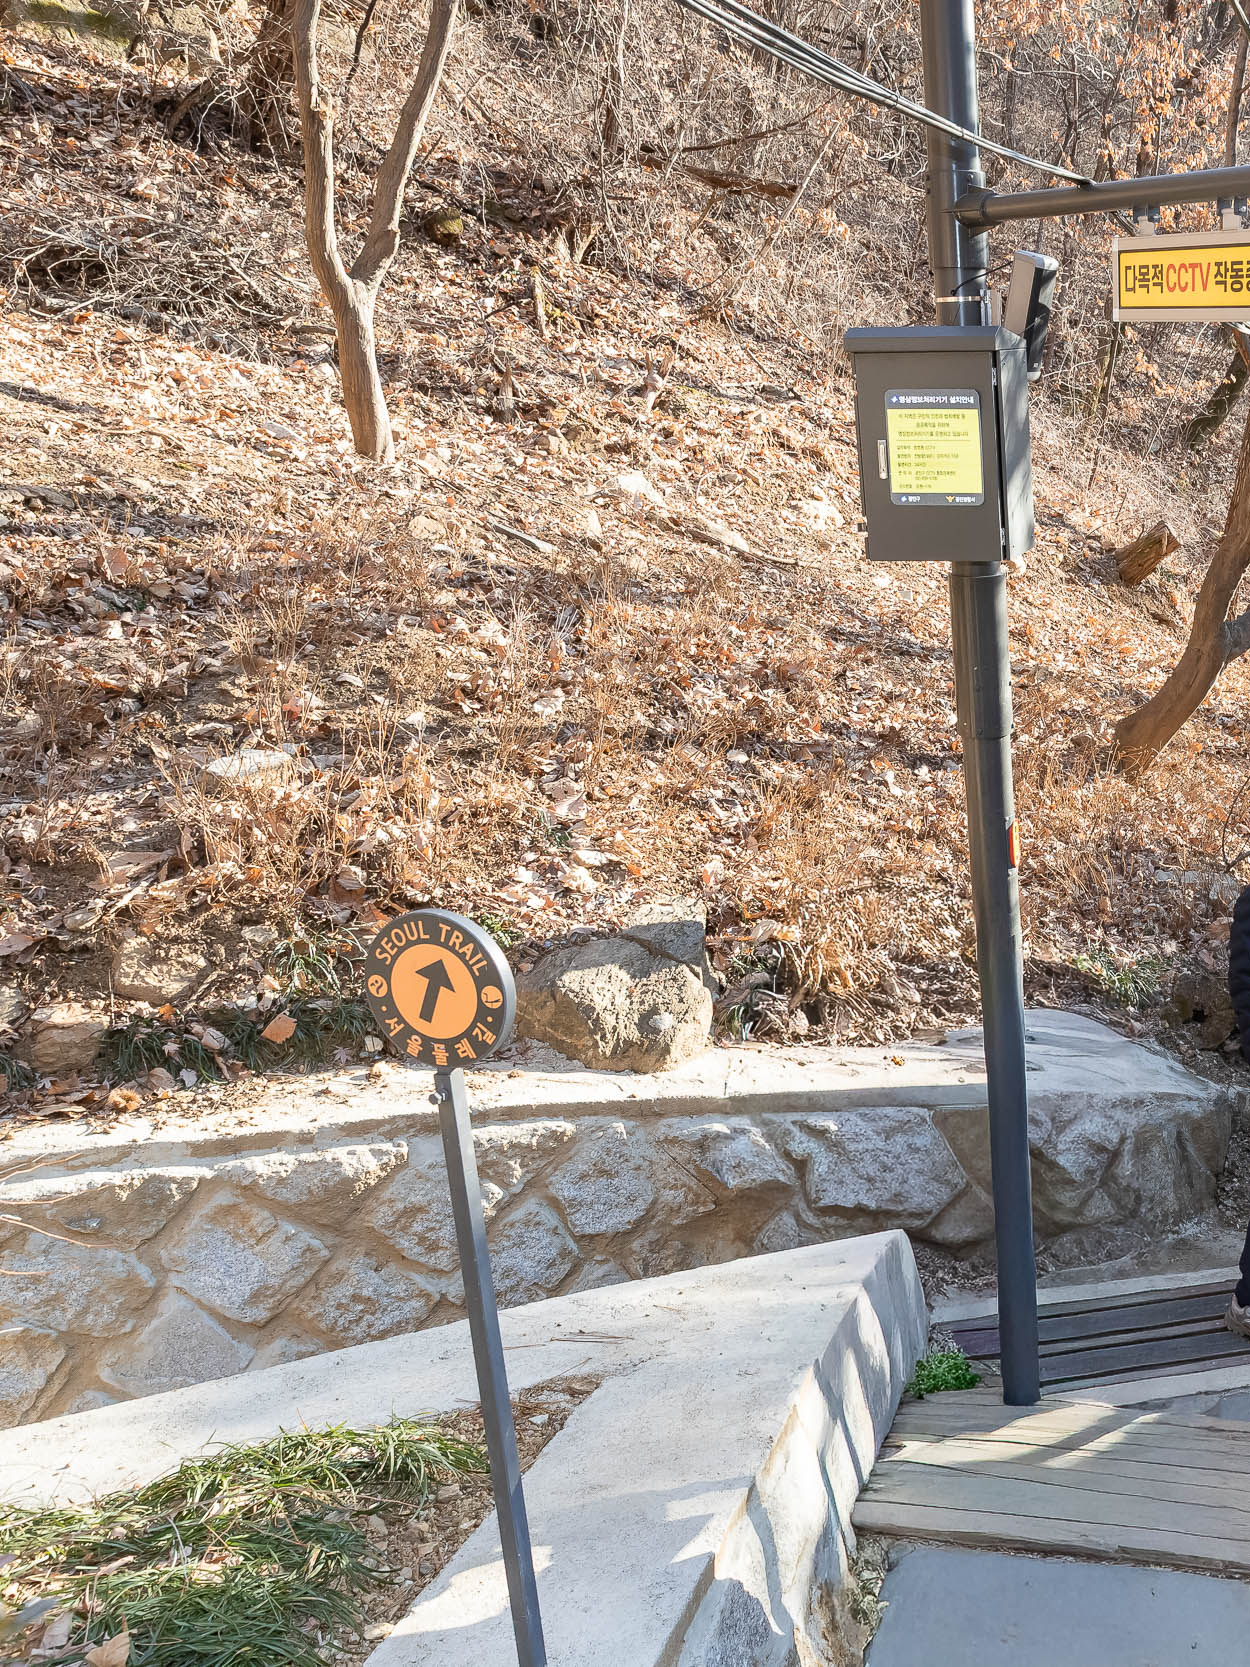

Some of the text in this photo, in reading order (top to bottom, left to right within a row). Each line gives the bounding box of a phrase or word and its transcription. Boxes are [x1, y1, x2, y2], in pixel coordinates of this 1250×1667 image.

[949, 395, 974, 403] 설치안내
[375, 920, 488, 976] SEOUL TRAIL
[385, 1017, 496, 1066] 서울둘레길
